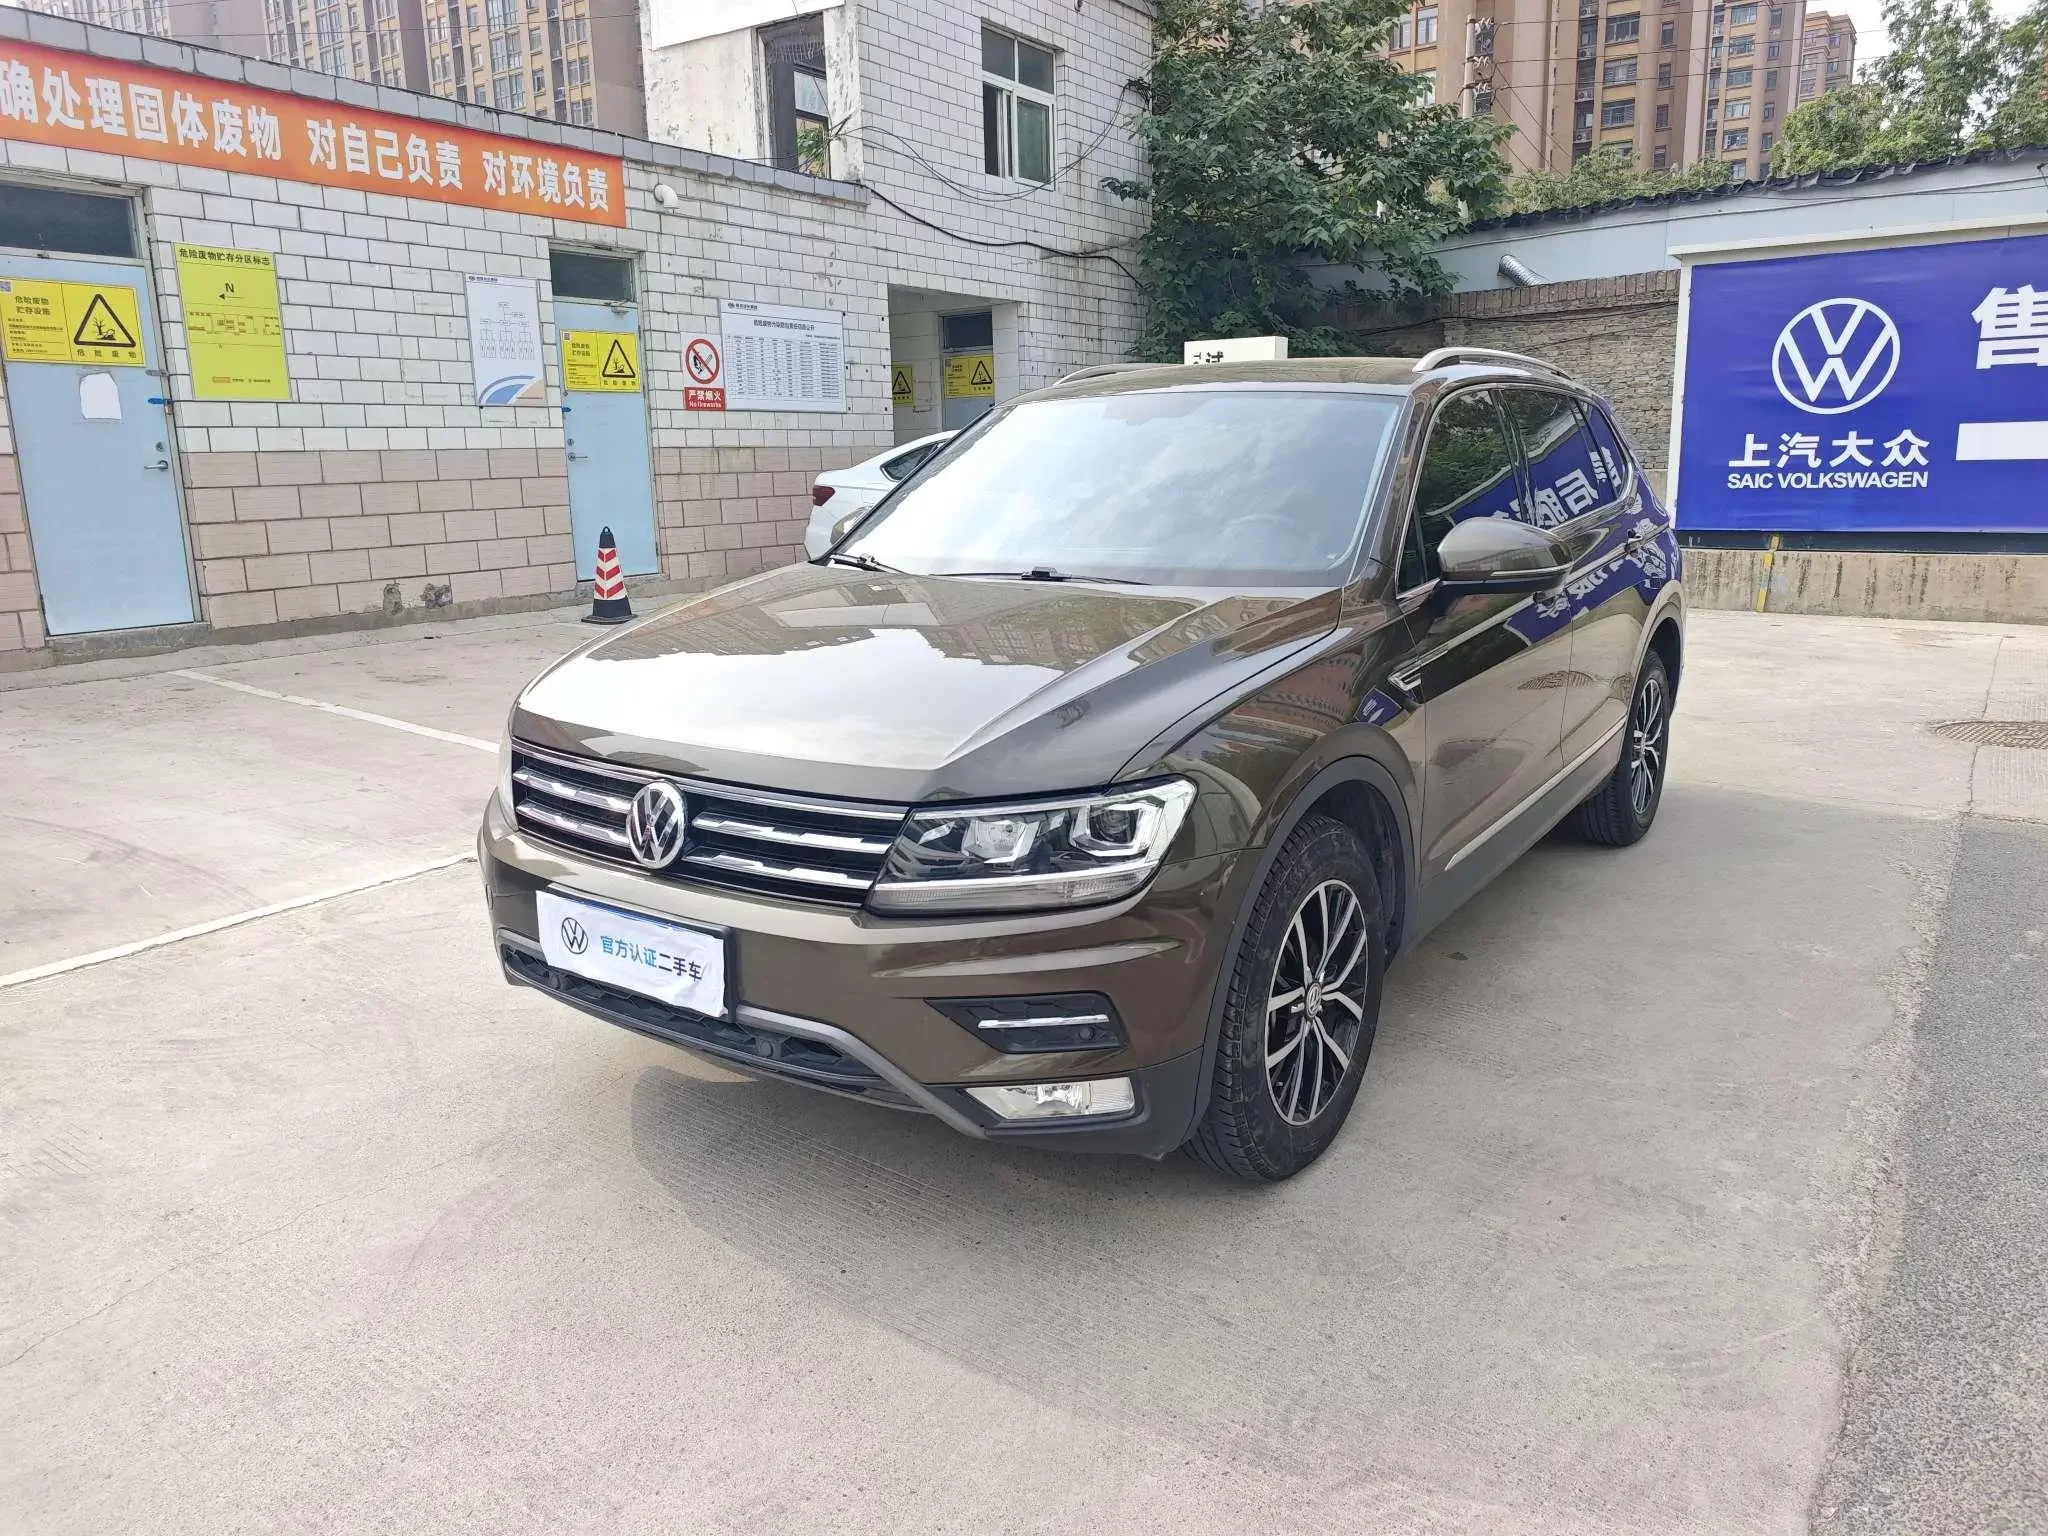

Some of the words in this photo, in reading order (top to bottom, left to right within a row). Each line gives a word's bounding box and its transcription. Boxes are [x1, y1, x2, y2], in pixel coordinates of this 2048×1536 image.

[0, 59, 281, 160] 确处理固体废物
[306, 118, 463, 191] 对自己负责
[482, 150, 610, 213] 对环境负责
[225, 282, 235, 293] N
[688, 389, 722, 401] 严禁烟火
[1728, 428, 1930, 469] 上汽大众
[1727, 473, 1774, 490] SAIC
[1777, 471, 1929, 489] VOLKSWAGEN
[600, 934, 703, 982] 官方认证二手车
